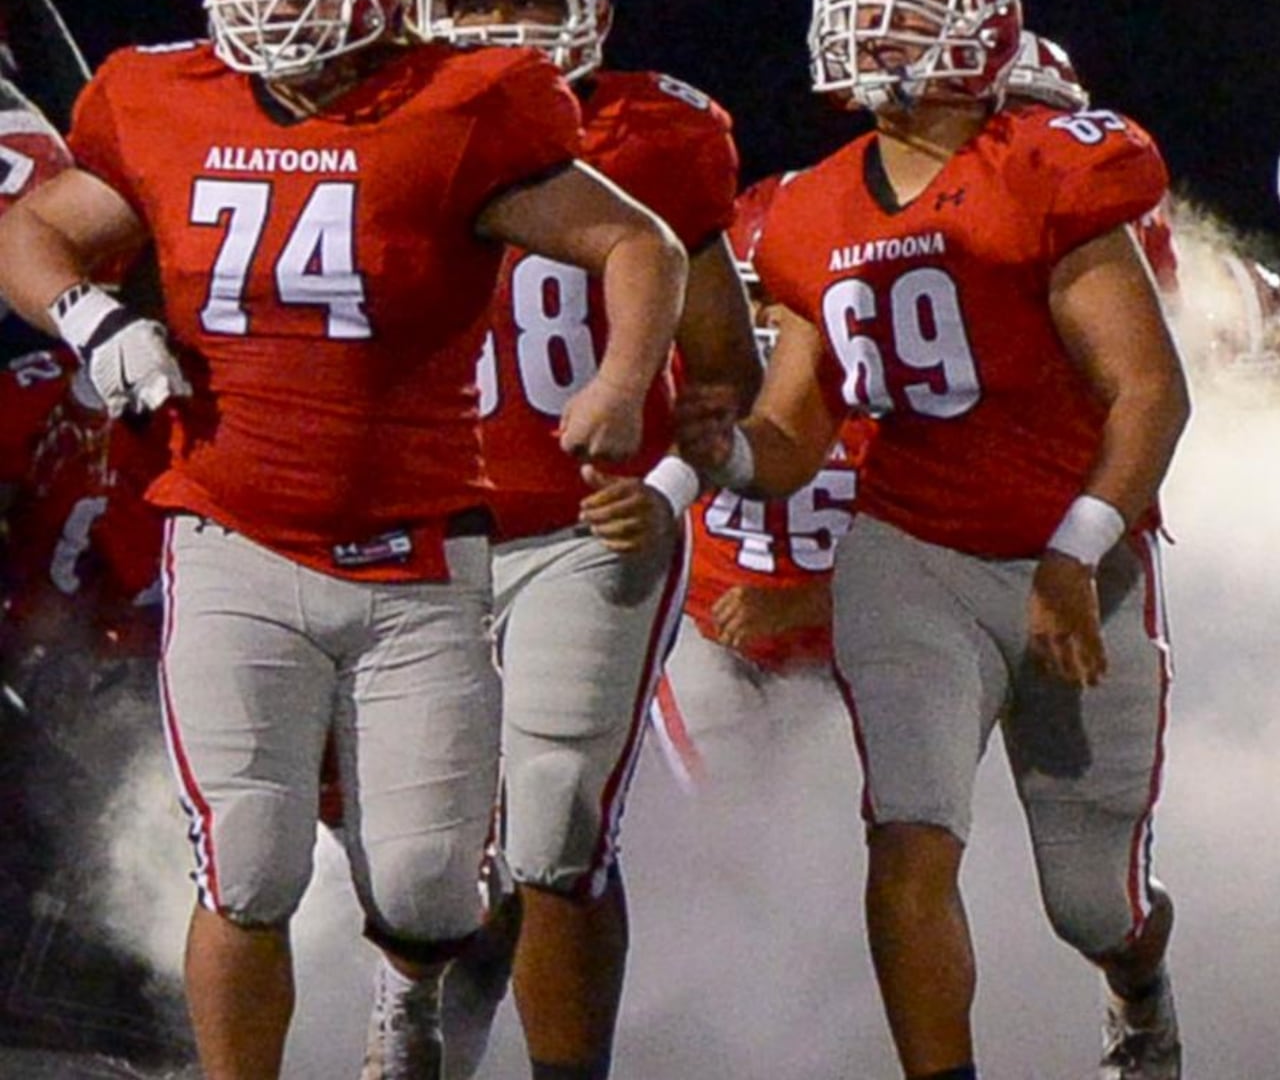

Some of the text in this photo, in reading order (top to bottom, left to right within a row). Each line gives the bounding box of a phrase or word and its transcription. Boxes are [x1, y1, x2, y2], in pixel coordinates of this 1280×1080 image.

[204, 146, 358, 172] ALLATOONA
[189, 178, 372, 339] 74
[828, 233, 946, 271] ALLATOONA
[820, 267, 982, 418] 69
[704, 469, 857, 573] 45
